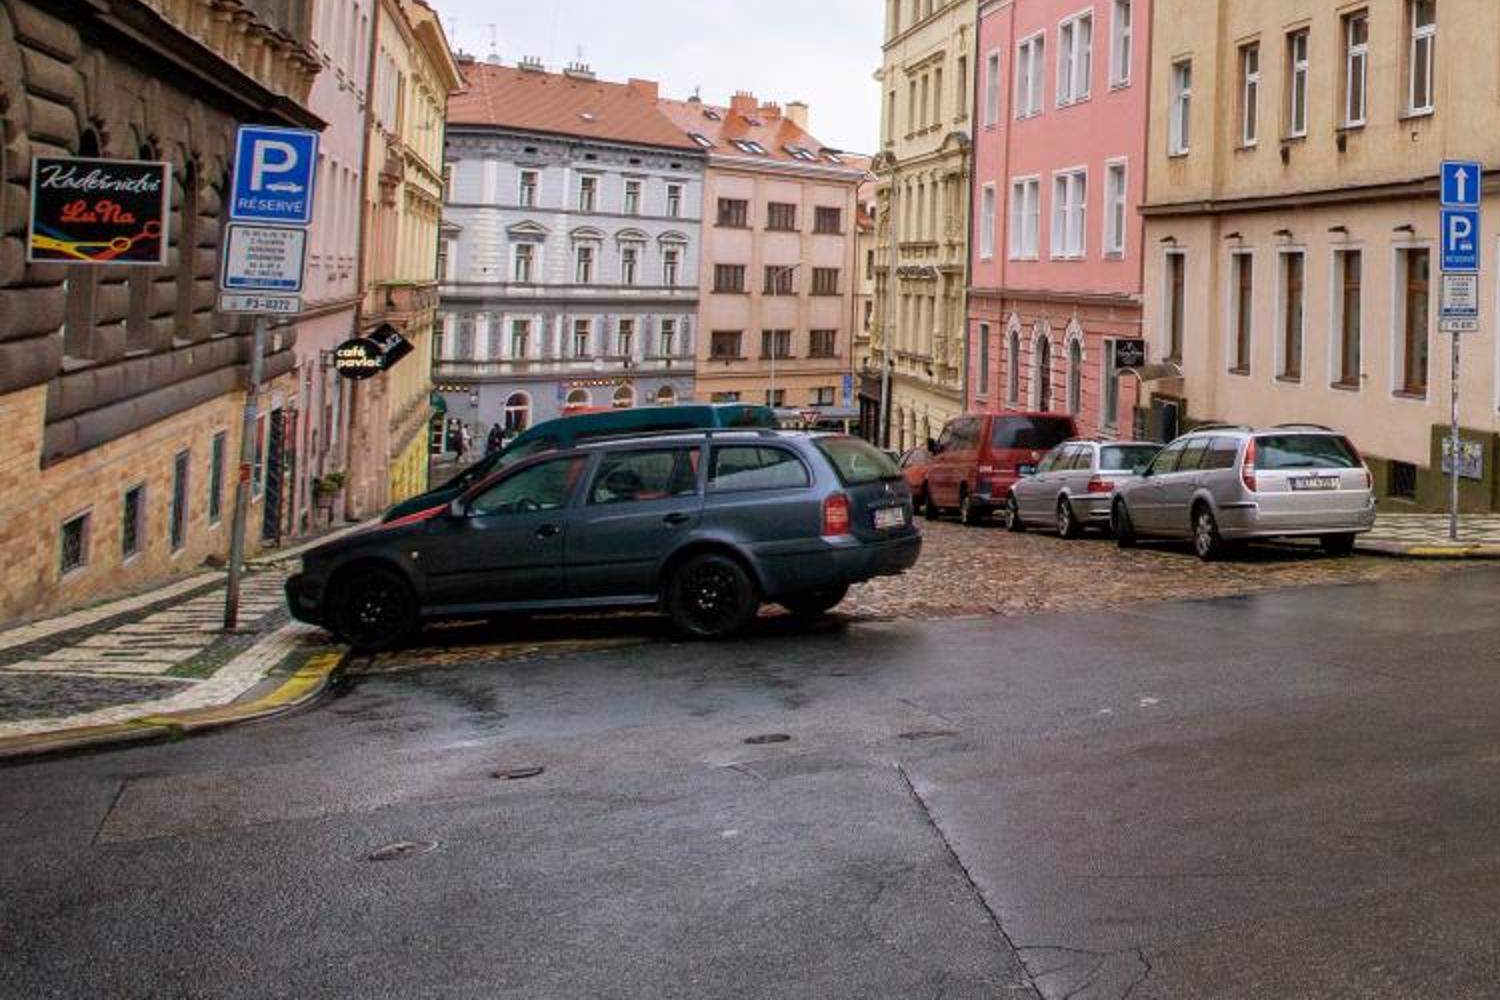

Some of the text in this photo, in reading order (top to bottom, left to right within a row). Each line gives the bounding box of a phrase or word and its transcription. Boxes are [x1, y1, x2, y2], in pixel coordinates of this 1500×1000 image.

[251, 139, 298, 191] P
[1449, 215, 1472, 251] P
[337, 345, 366, 357] café
